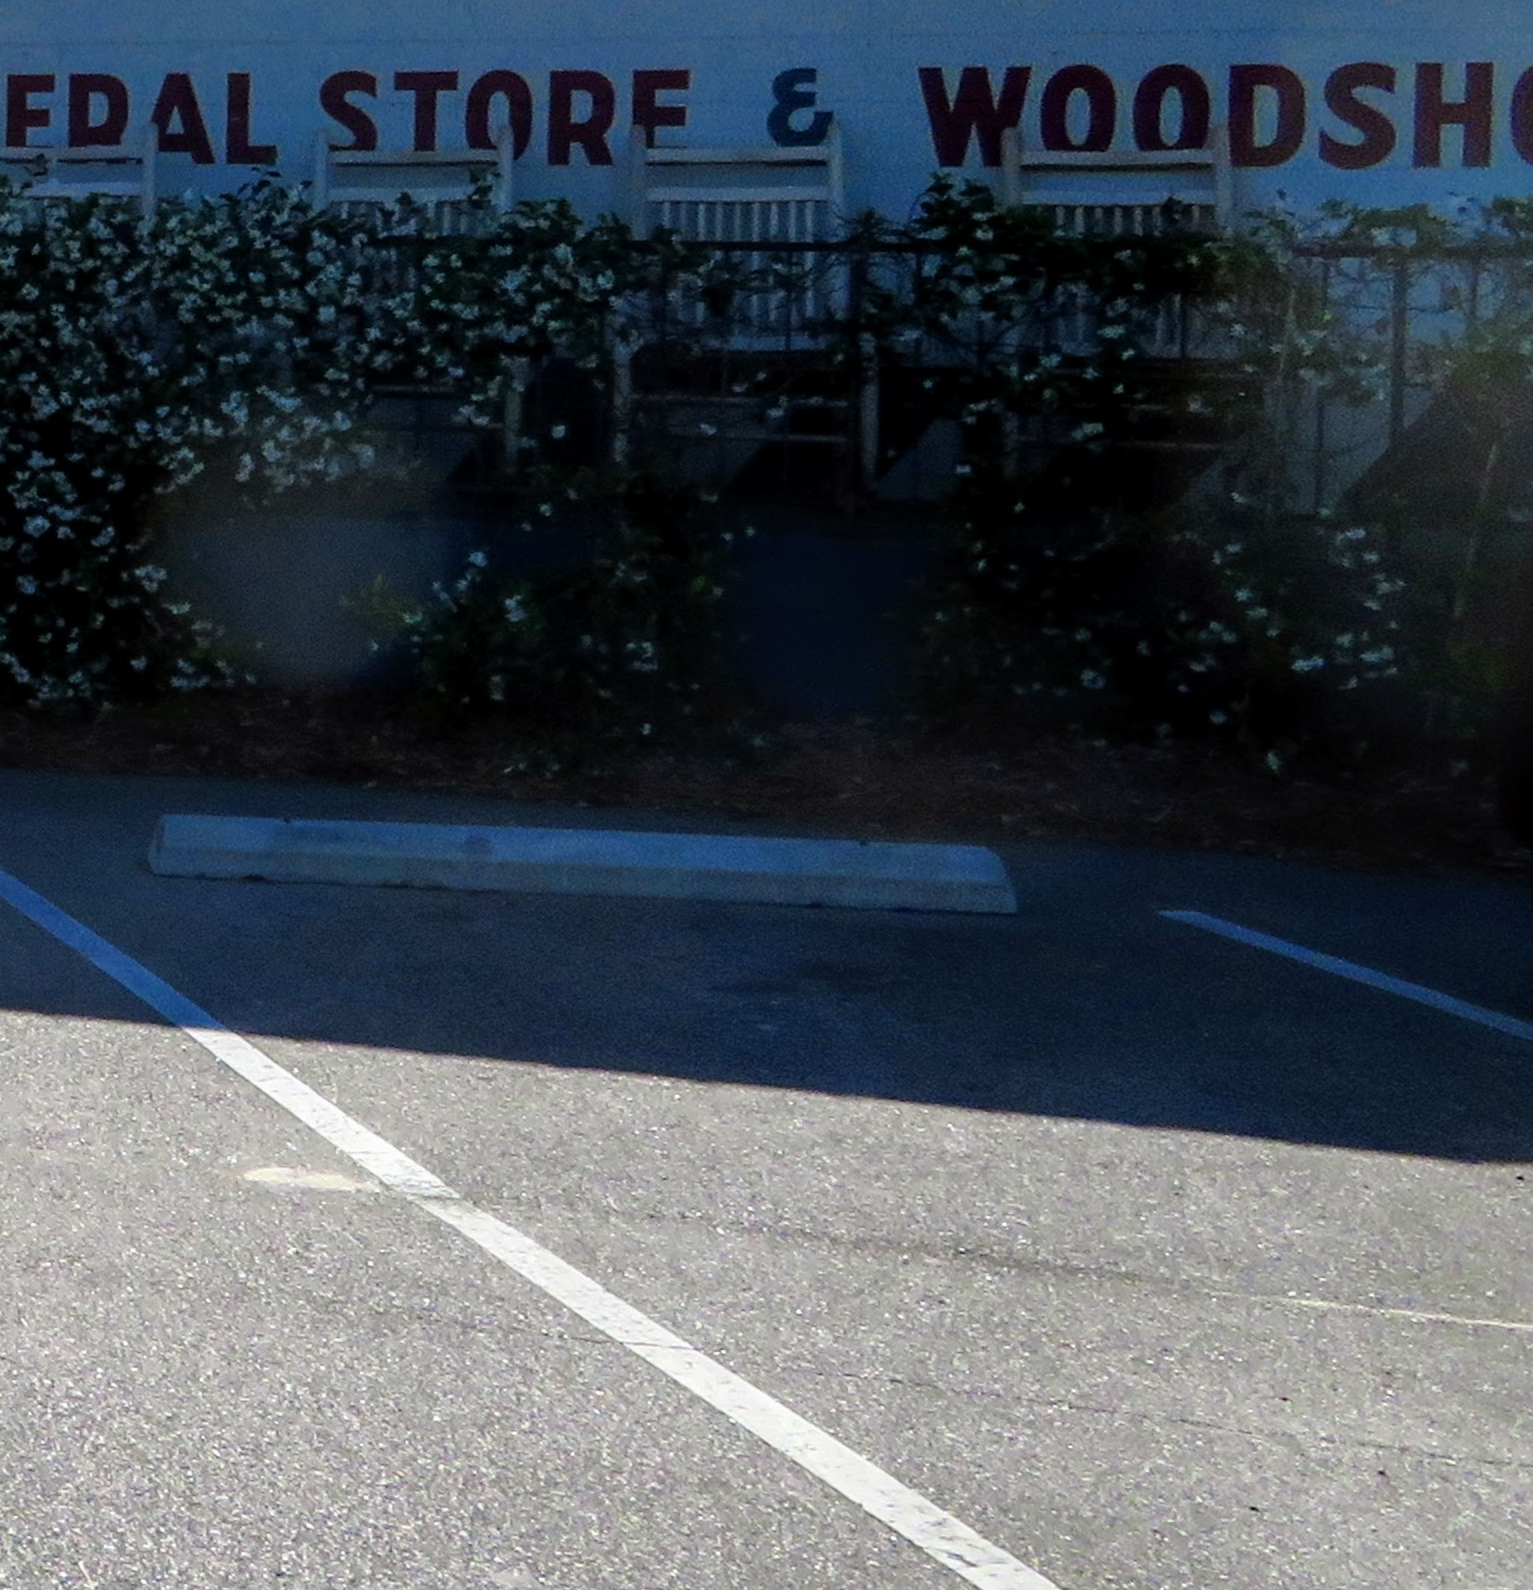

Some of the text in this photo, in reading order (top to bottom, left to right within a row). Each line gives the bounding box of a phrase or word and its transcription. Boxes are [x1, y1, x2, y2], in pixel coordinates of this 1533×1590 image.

[317, 68, 692, 166] STORE
[766, 67, 836, 148] &
[918, 61, 1533, 171] WOODSH
